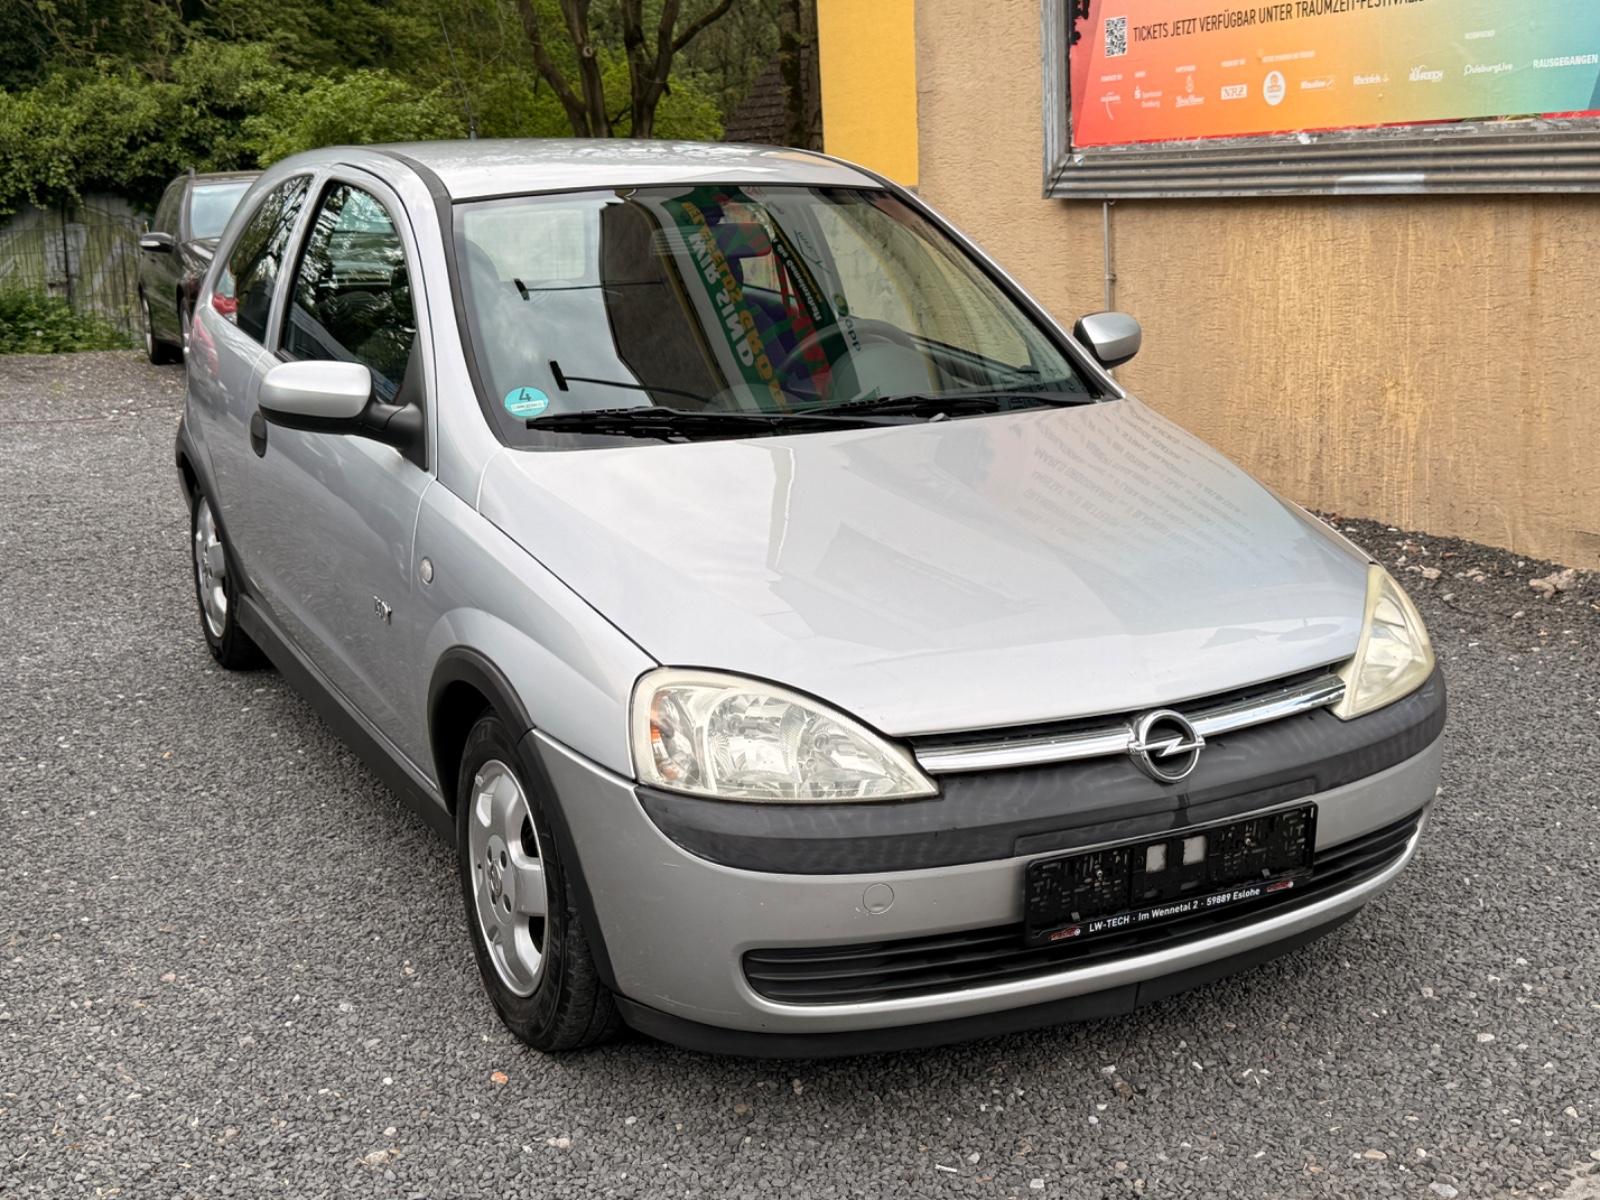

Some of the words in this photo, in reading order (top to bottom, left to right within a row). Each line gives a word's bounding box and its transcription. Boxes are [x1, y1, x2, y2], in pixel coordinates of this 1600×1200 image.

[1133, 22, 1168, 42] TICKETS
[1170, 18, 1197, 37] JETZT
[1199, 9, 1256, 32] VERFÜGBAR
[1258, 3, 1293, 24] UNTER
[1532, 53, 1599, 69] RAUSGEGANGEN
[519, 388, 532, 401] 4
[1089, 915, 1130, 933] LW-TECH
[1138, 912, 1150, 921] Im
[1151, 901, 1191, 918] Wennetal
[1192, 900, 1199, 909] 2
[1206, 893, 1231, 906] 59889
[1233, 888, 1261, 900] Eslohe
